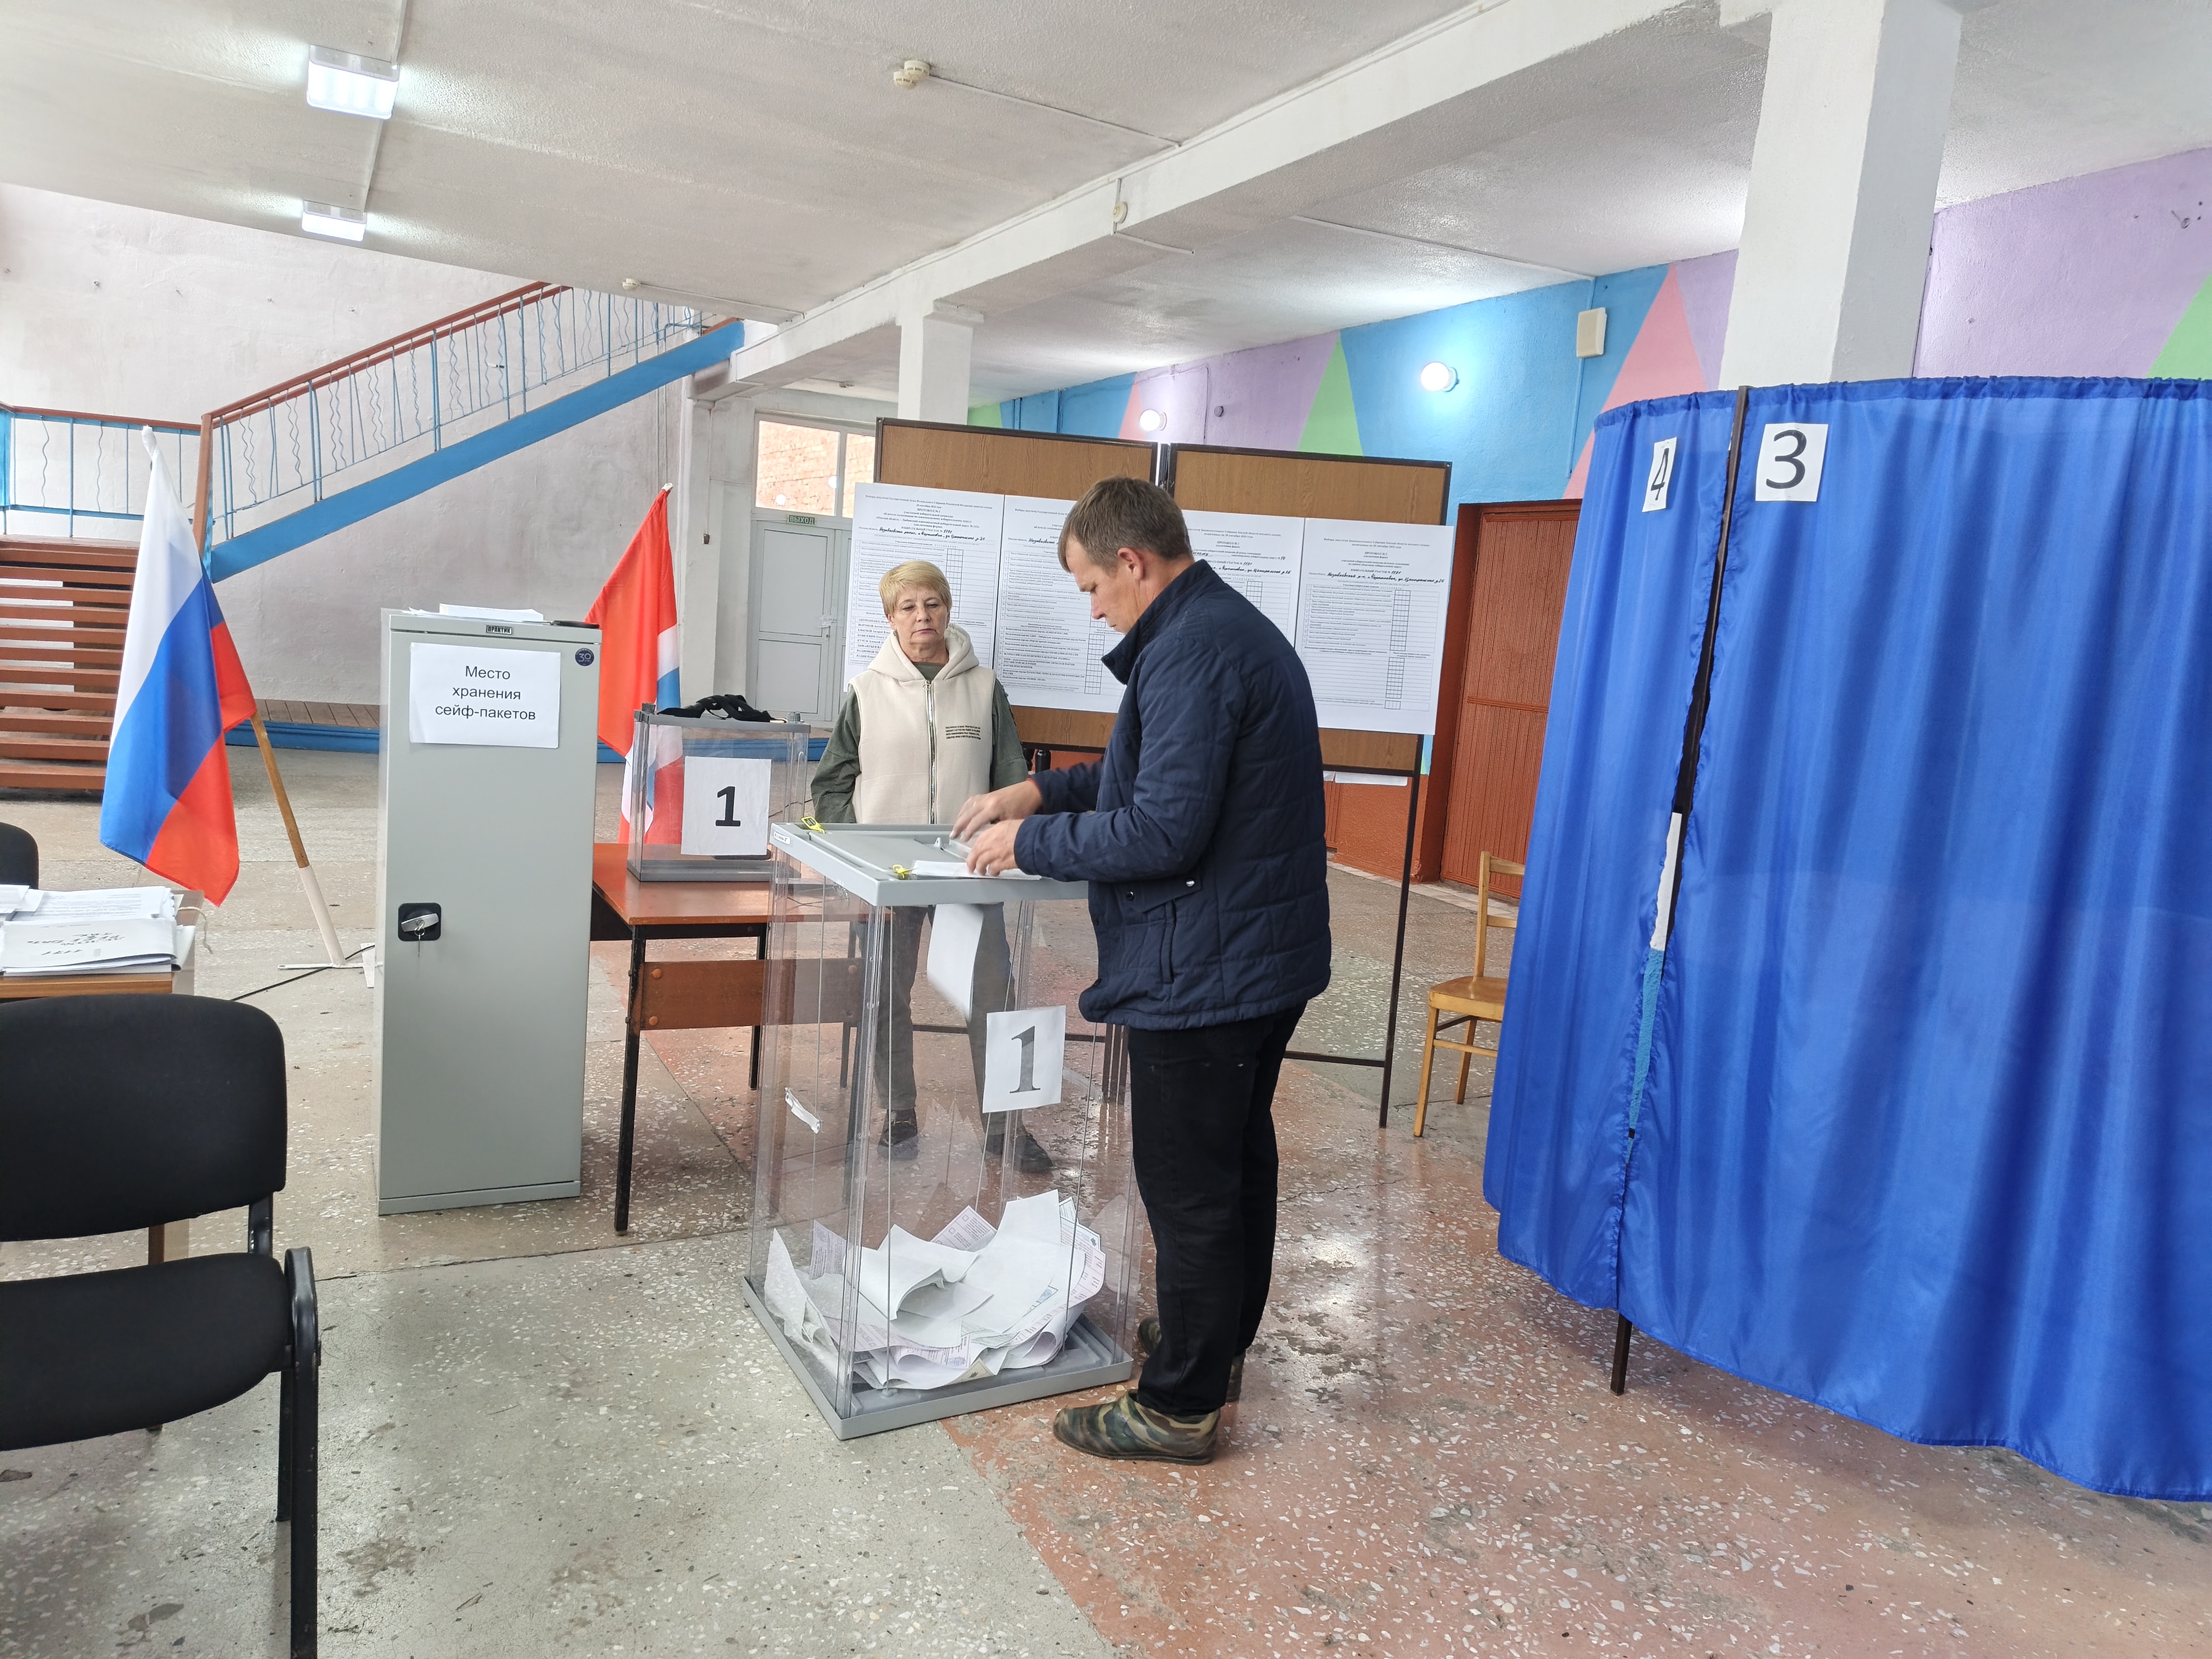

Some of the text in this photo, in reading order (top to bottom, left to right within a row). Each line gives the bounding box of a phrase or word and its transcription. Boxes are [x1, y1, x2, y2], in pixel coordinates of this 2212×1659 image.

[1766, 429, 1807, 489] 3
[1650, 448, 1669, 500] 4
[789, 516, 815, 525] ВЫХОД
[578, 653, 591, 662] 30
[465, 665, 511, 680] Место
[452, 687, 521, 699] хранения
[435, 705, 536, 720] сейф-пакетов
[715, 786, 741, 827] 1
[1009, 1025, 1042, 1095] 1
